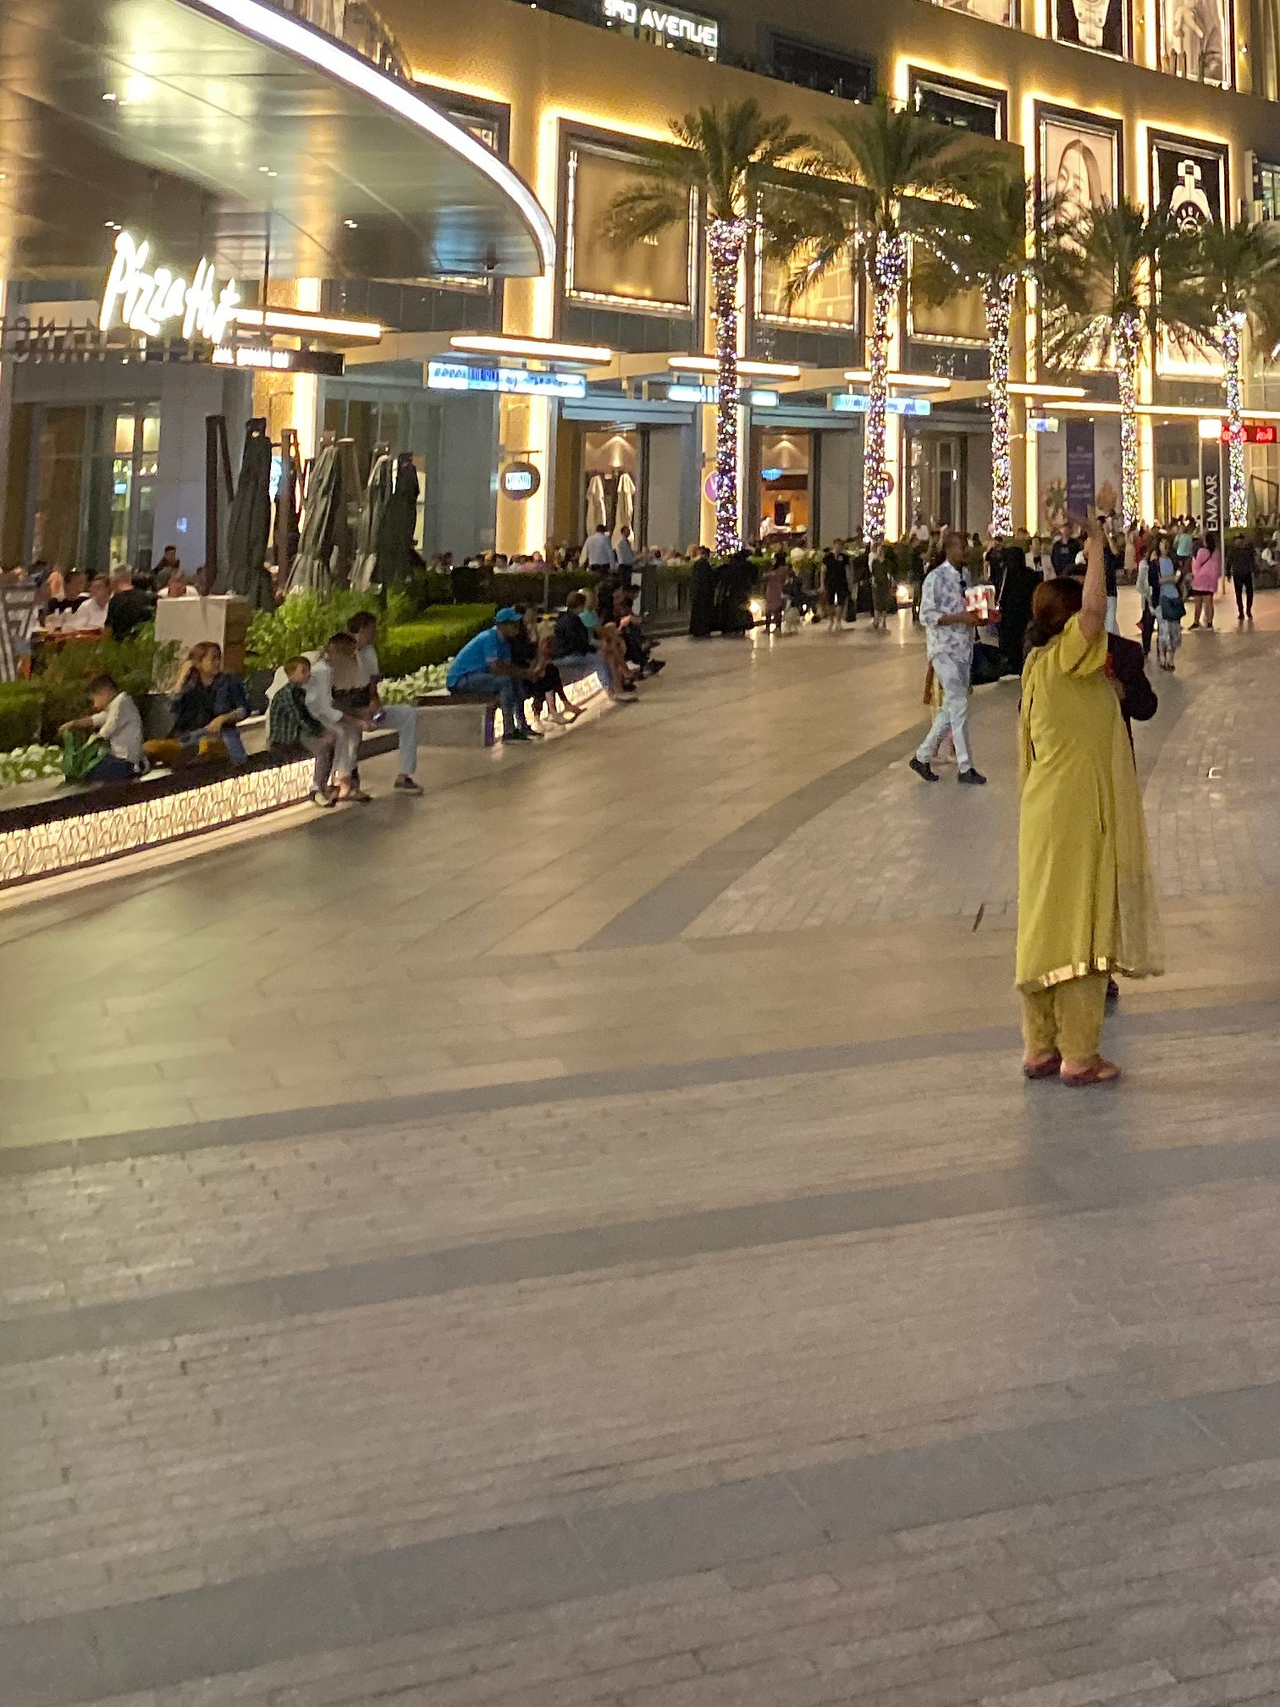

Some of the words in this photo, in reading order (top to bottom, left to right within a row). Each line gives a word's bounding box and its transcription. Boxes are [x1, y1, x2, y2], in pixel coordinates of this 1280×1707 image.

[640, 8, 718, 48] AVENUE
[100, 231, 187, 337] Pizza
[183, 257, 241, 345] Hut
[1205, 474, 1219, 532] EMAAR
